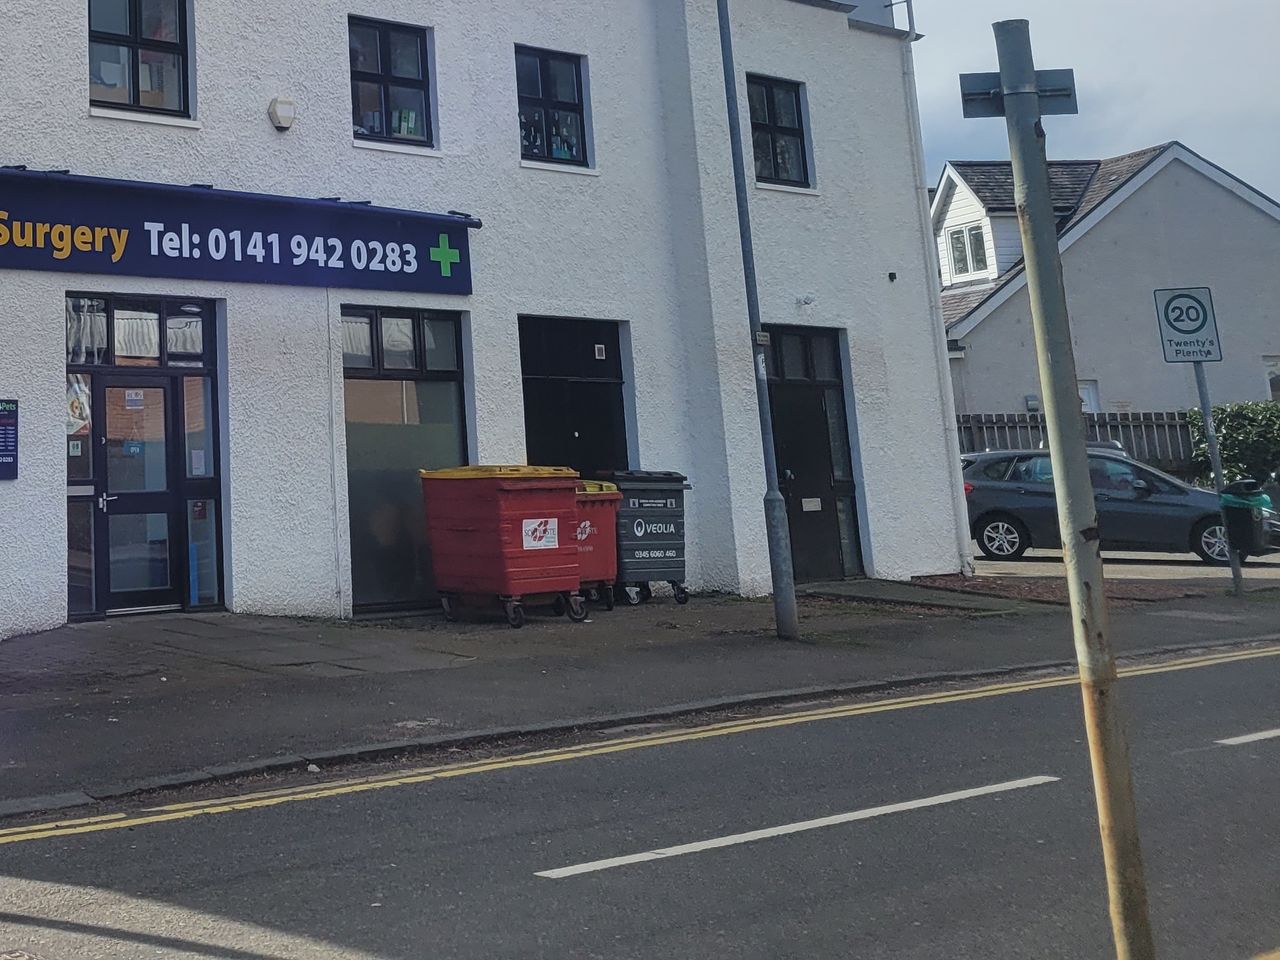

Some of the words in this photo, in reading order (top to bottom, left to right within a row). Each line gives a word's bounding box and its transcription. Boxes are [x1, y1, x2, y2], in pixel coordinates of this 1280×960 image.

[144, 221, 201, 258] Tel:
[208, 228, 280, 264] 0141
[291, 234, 344, 268] 942
[350, 239, 418, 273] 0283
[1171, 305, 1200, 323] 20
[1167, 338, 1215, 348] Twenty's
[646, 523, 675, 533] VEOLIA
[634, 550, 650, 558] 0345
[650, 550, 665, 558] 6060
